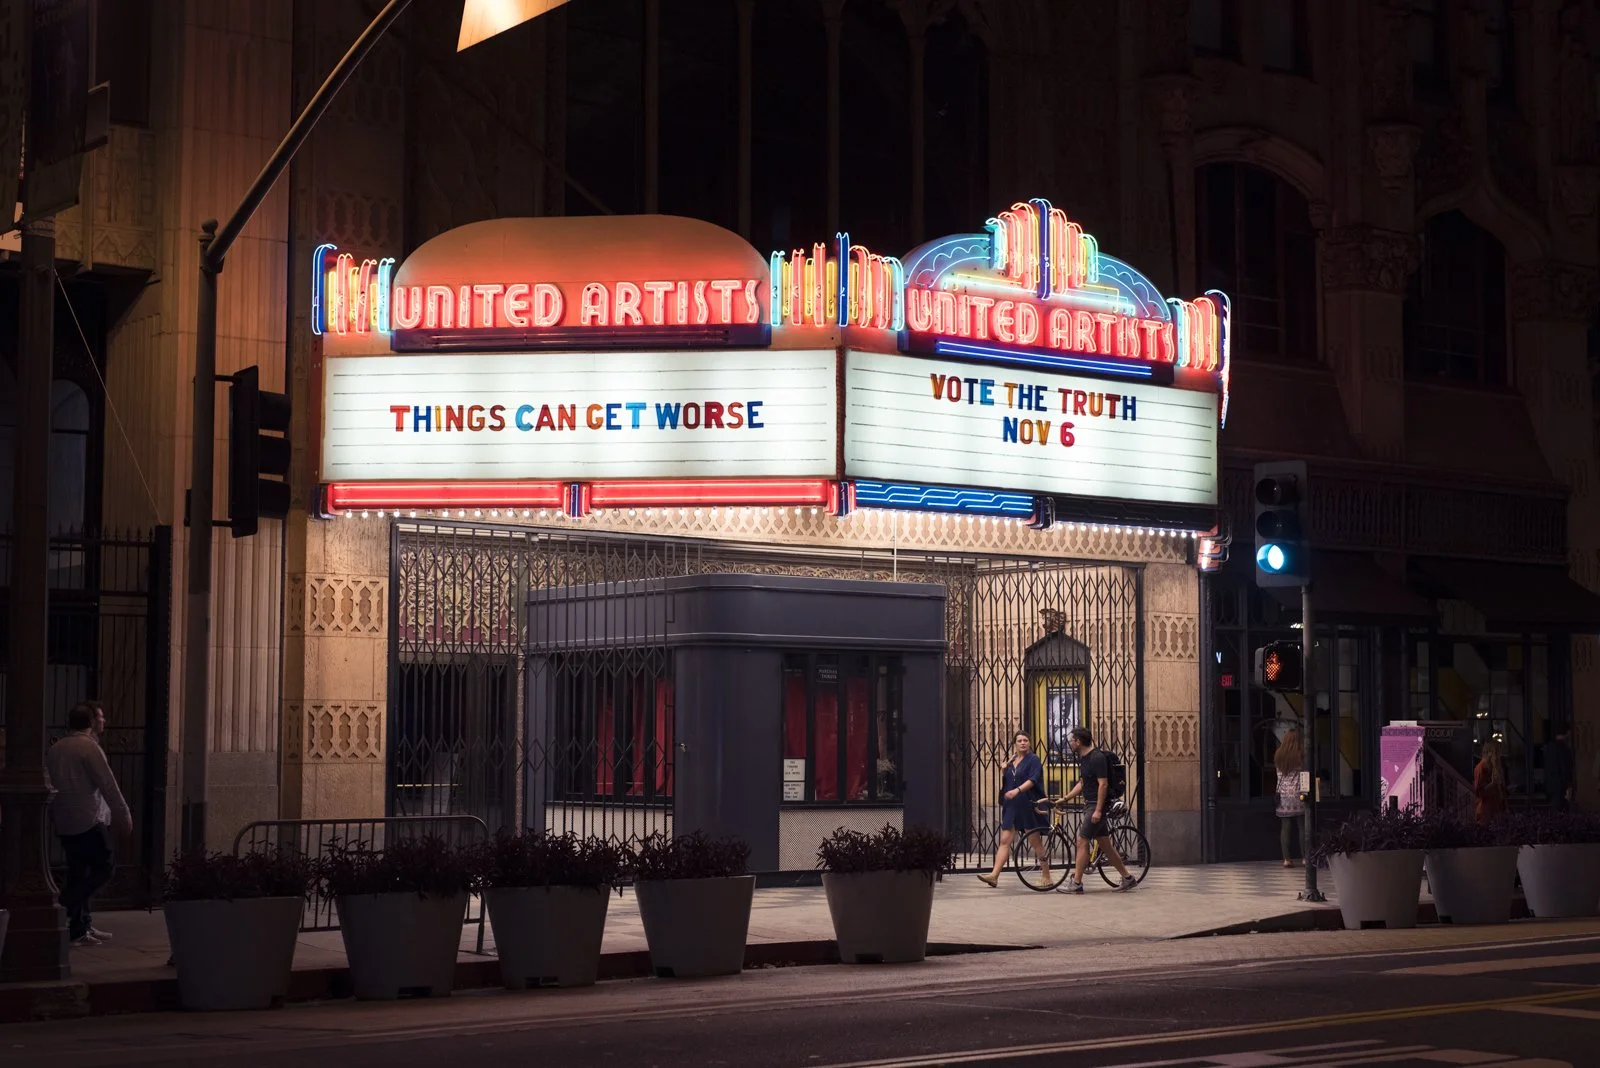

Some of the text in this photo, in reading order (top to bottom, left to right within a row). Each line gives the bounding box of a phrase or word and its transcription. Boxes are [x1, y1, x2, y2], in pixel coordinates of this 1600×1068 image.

[394, 280, 760, 329] UNITED ARTISTS
[908, 288, 1175, 362] UNITED ARTISTS
[390, 401, 764, 433] THINGS CAN GET WORSE
[931, 373, 1137, 421] VOTE THE TRUTH
[1003, 416, 1075, 448] NOV 6
[1221, 675, 1233, 687] EXIT
